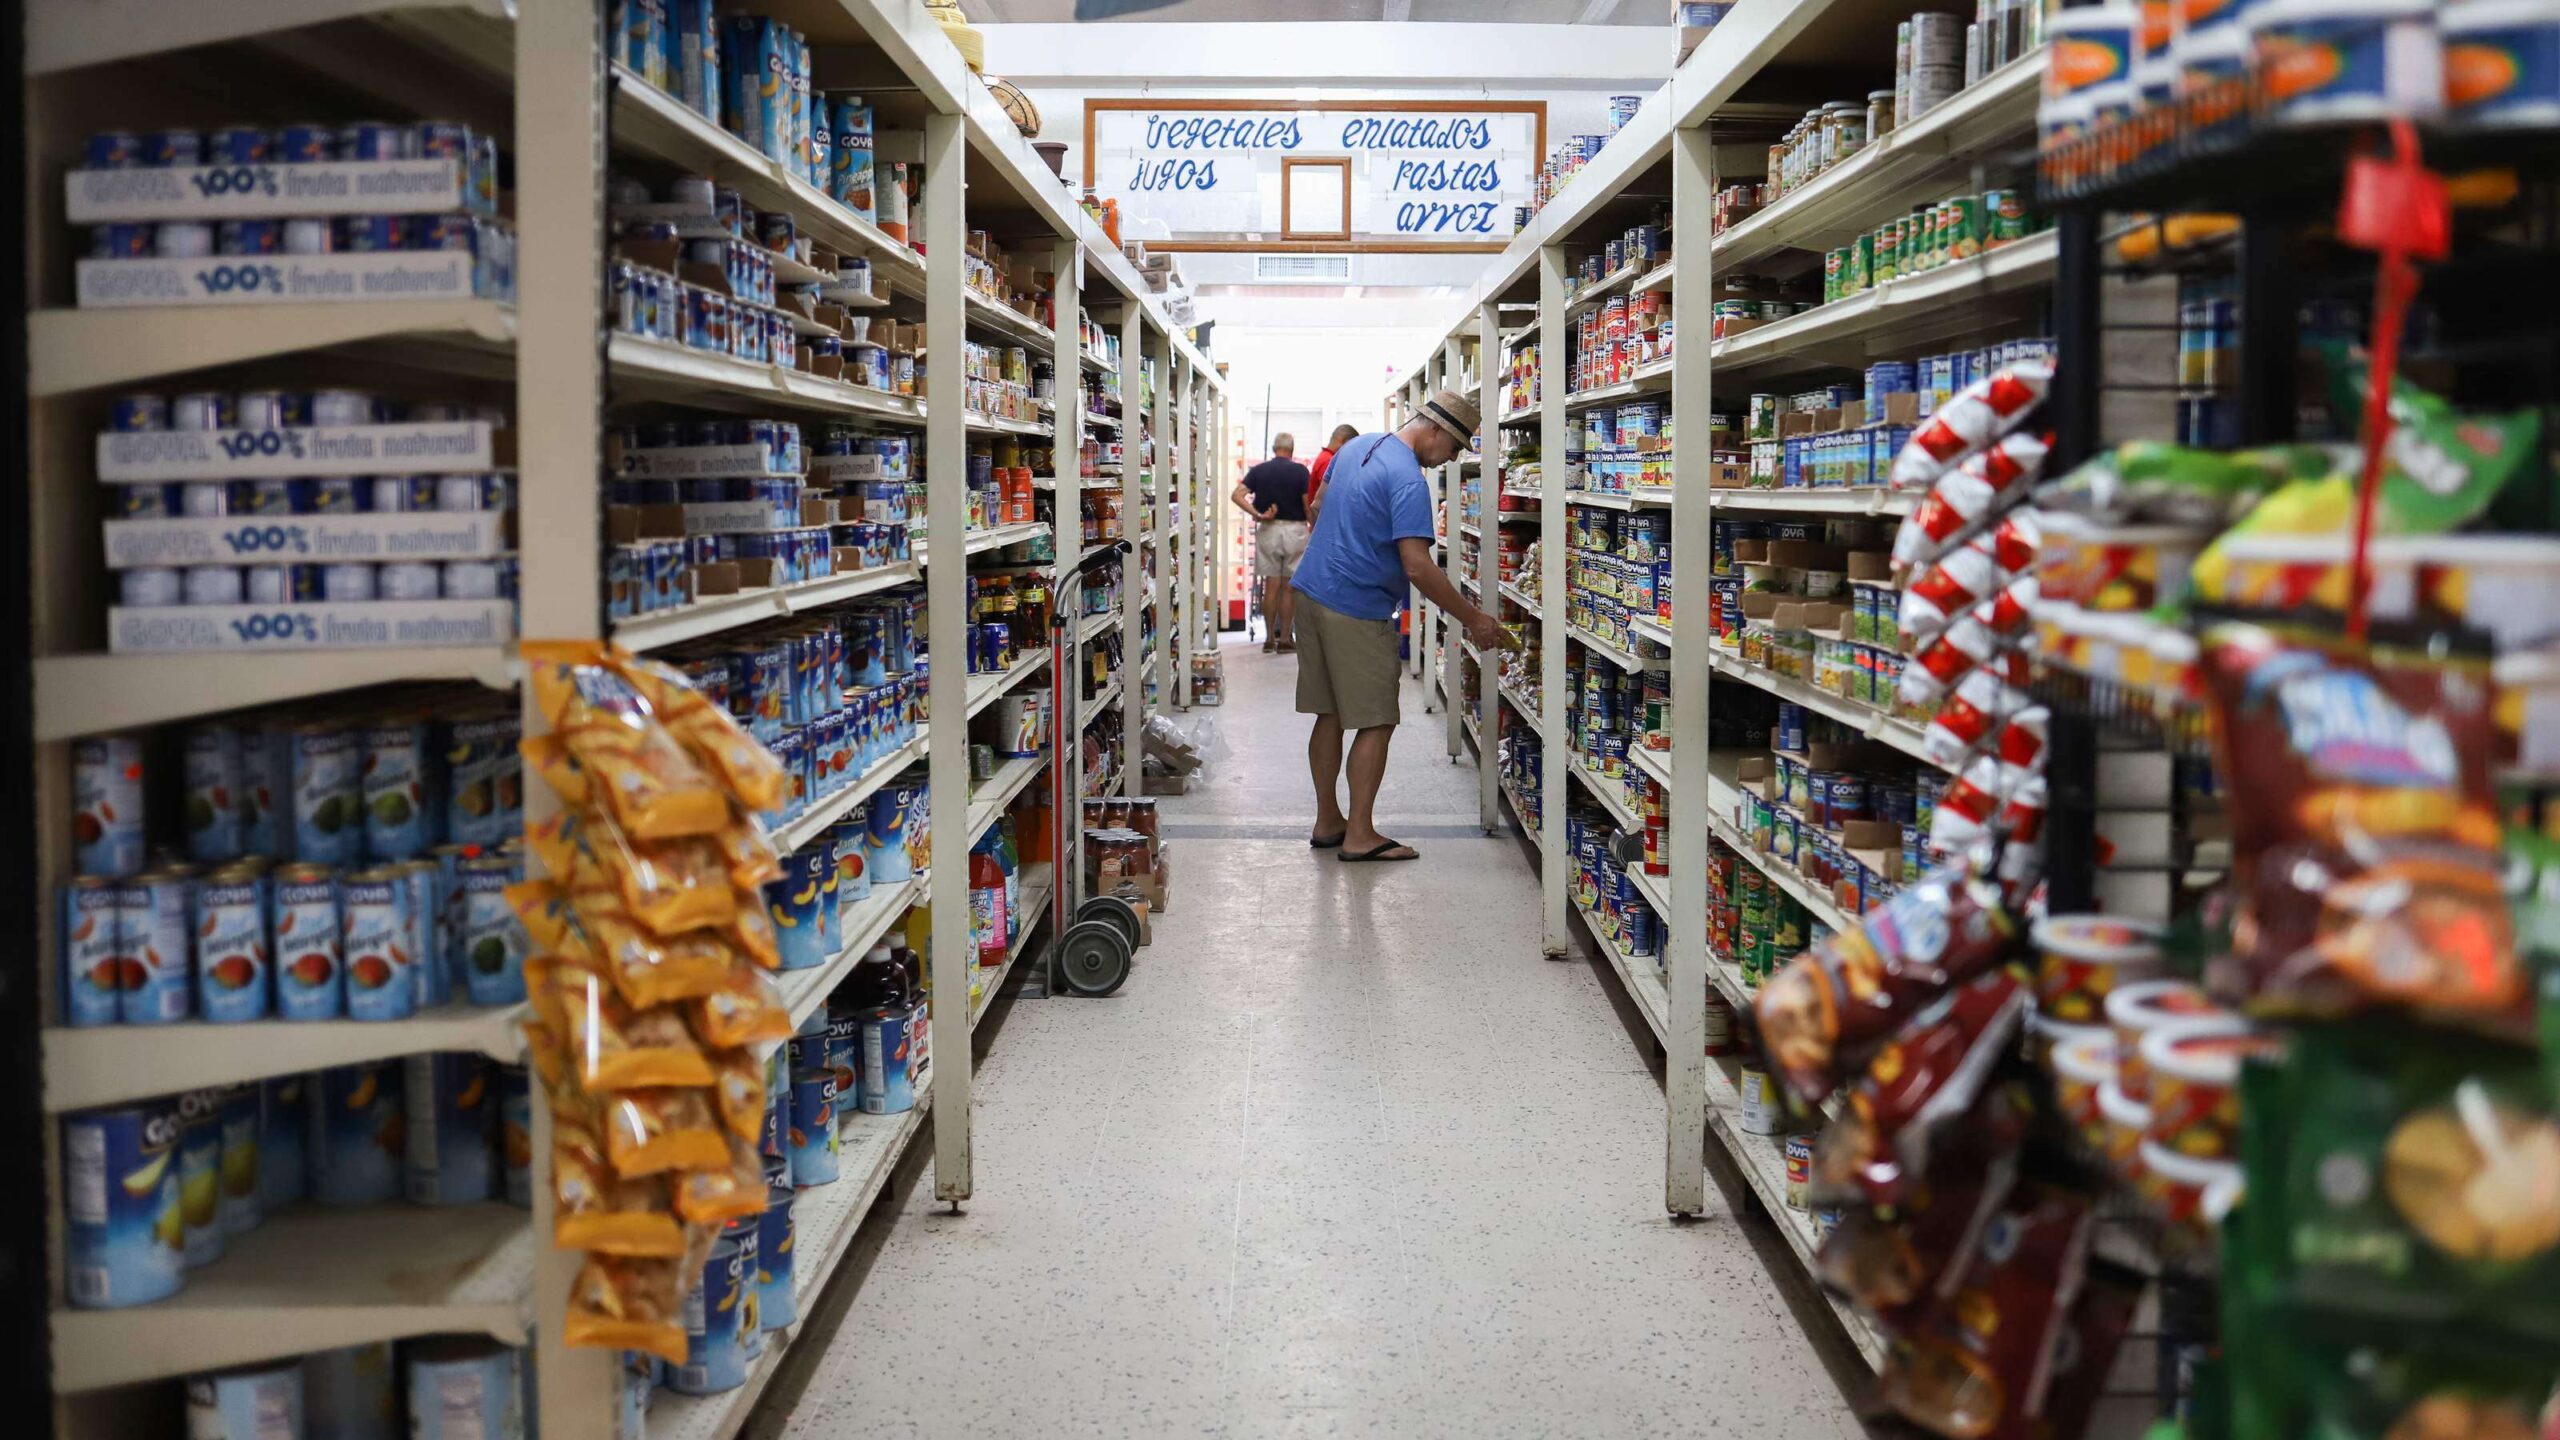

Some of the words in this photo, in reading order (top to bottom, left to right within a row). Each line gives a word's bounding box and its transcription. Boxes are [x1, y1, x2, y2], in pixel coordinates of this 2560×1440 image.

[192, 168, 278, 198] 100%
[356, 166, 451, 196] natural
[837, 167, 873, 186] Pineapp
[197, 264, 283, 295] 100%
[362, 261, 458, 292] natural
[1710, 417, 1727, 425] OYA
[217, 430, 304, 459] 100%
[384, 427, 476, 457] natural
[1722, 468, 1738, 480] Mi
[224, 525, 309, 555] 100%
[385, 523, 479, 554] natural
[230, 613, 318, 643] 100%
[395, 611, 493, 643] natural
[1604, 739, 1622, 748] OYA
